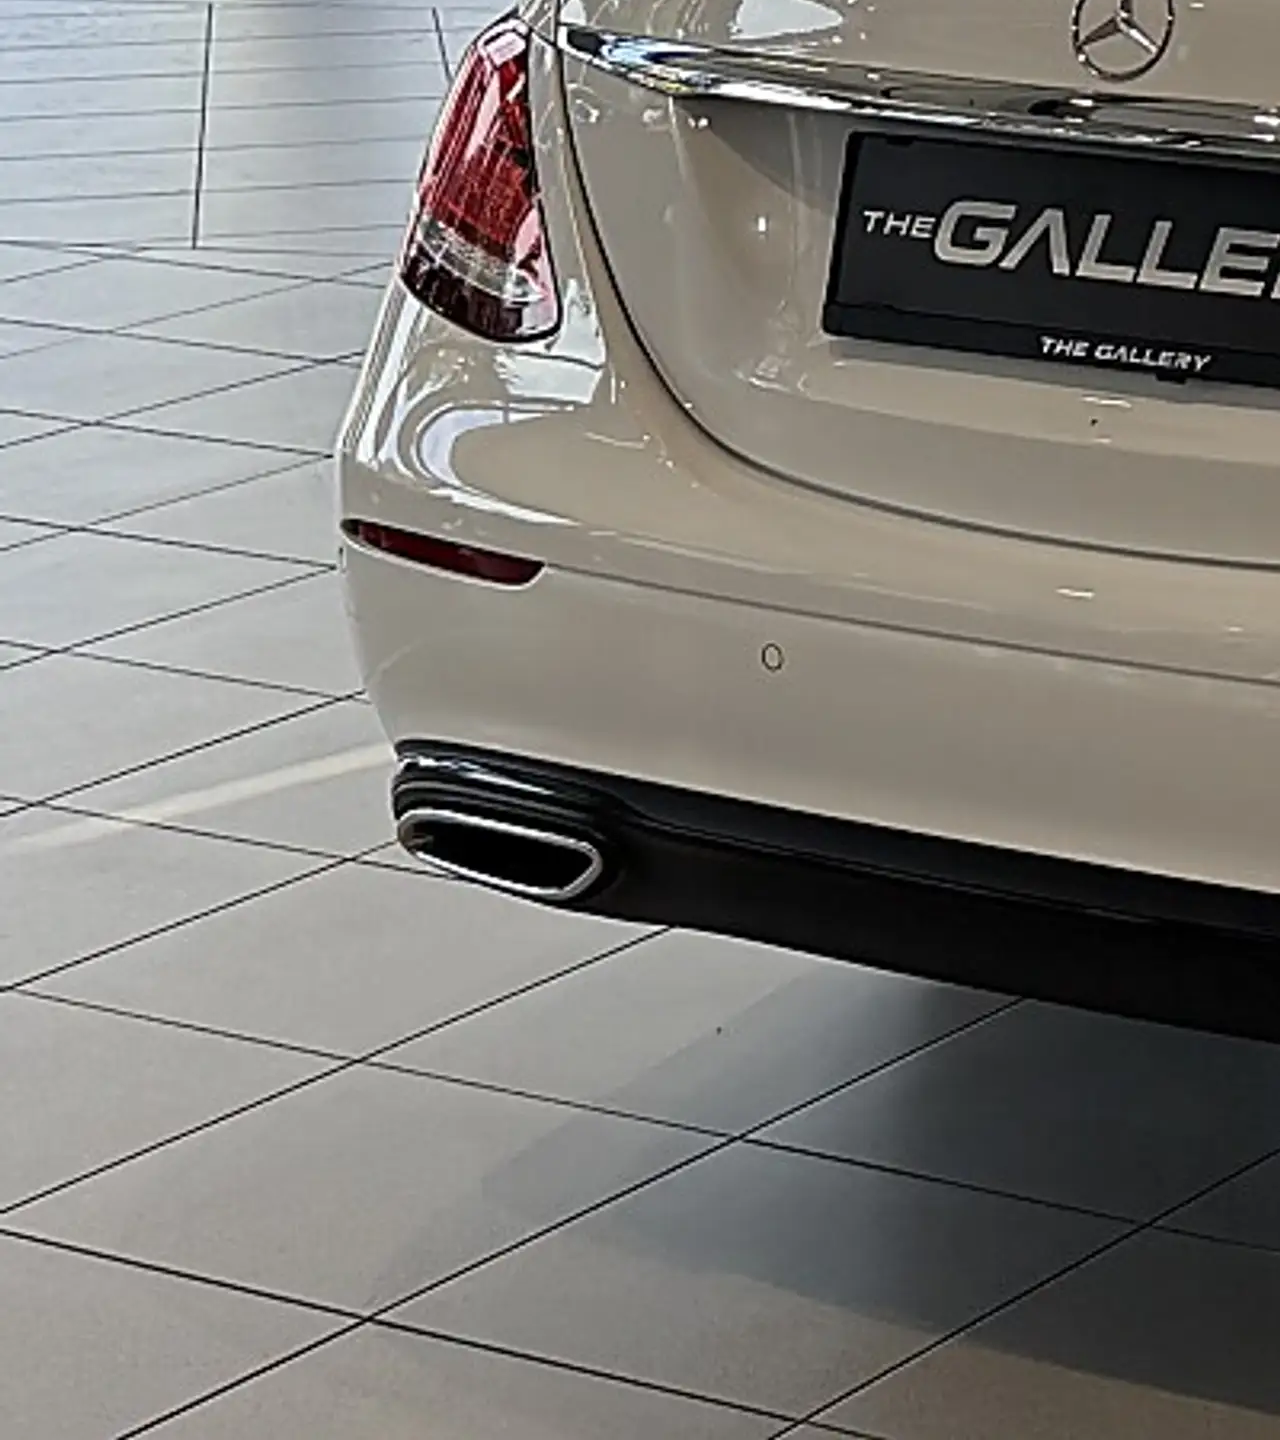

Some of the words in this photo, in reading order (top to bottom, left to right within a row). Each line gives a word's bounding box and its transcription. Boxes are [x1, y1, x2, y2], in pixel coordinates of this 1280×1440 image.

[862, 210, 937, 239] THE
[1041, 336, 1090, 356] THE
[1094, 344, 1212, 371] GALLERY
